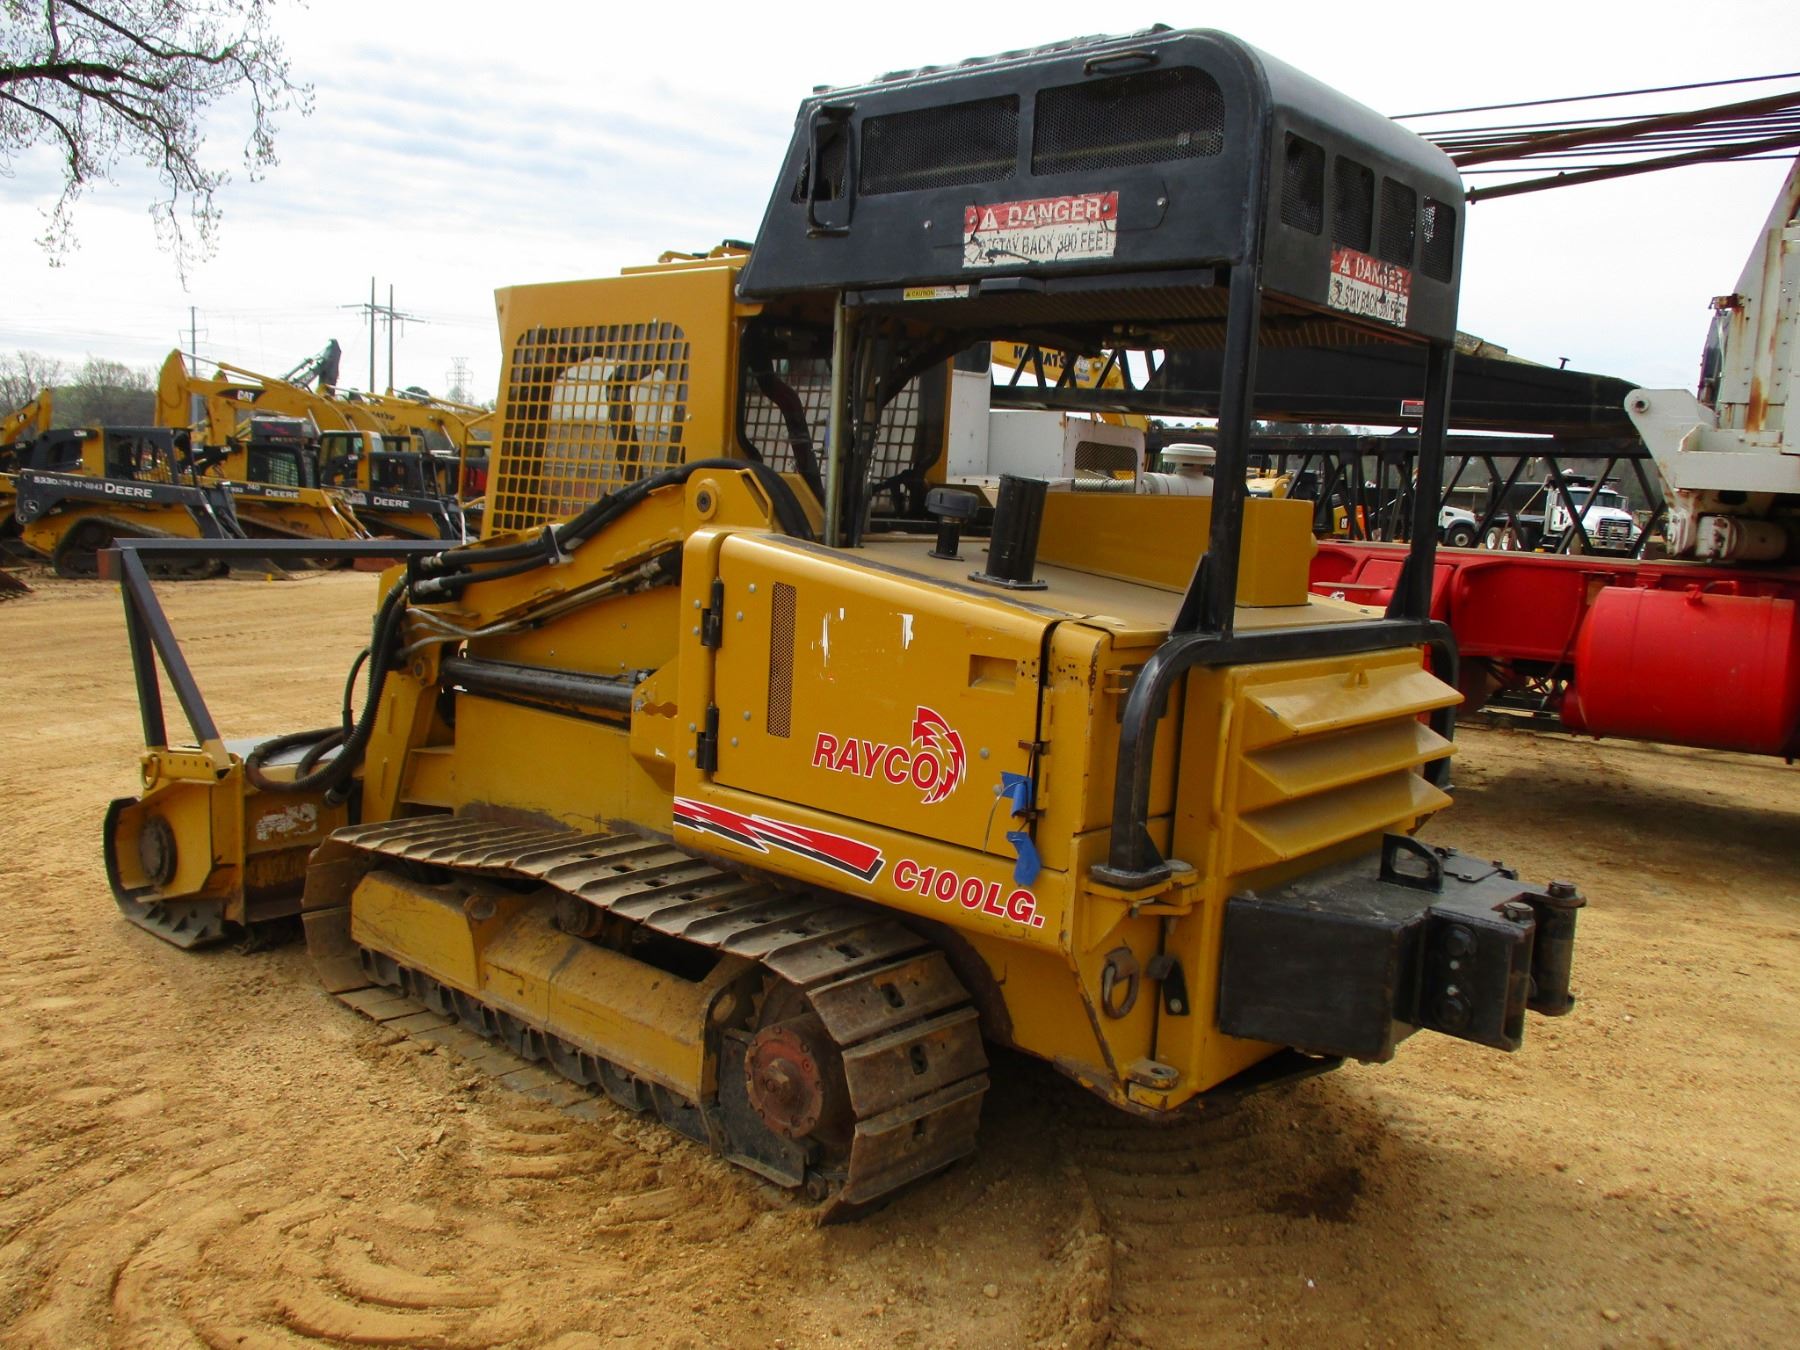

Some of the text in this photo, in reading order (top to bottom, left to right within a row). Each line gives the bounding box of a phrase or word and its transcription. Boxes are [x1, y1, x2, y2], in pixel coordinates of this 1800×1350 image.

[1008, 198, 1101, 227] DANGER
[1022, 234, 1054, 256] BACK
[1057, 231, 1078, 254] 300
[1080, 229, 1110, 250] FEET
[237, 390, 254, 402] CAT
[104, 482, 153, 498] DEERE
[265, 489, 299, 499] DEERE
[373, 496, 410, 508] DEERE
[811, 731, 941, 791] RAYCO
